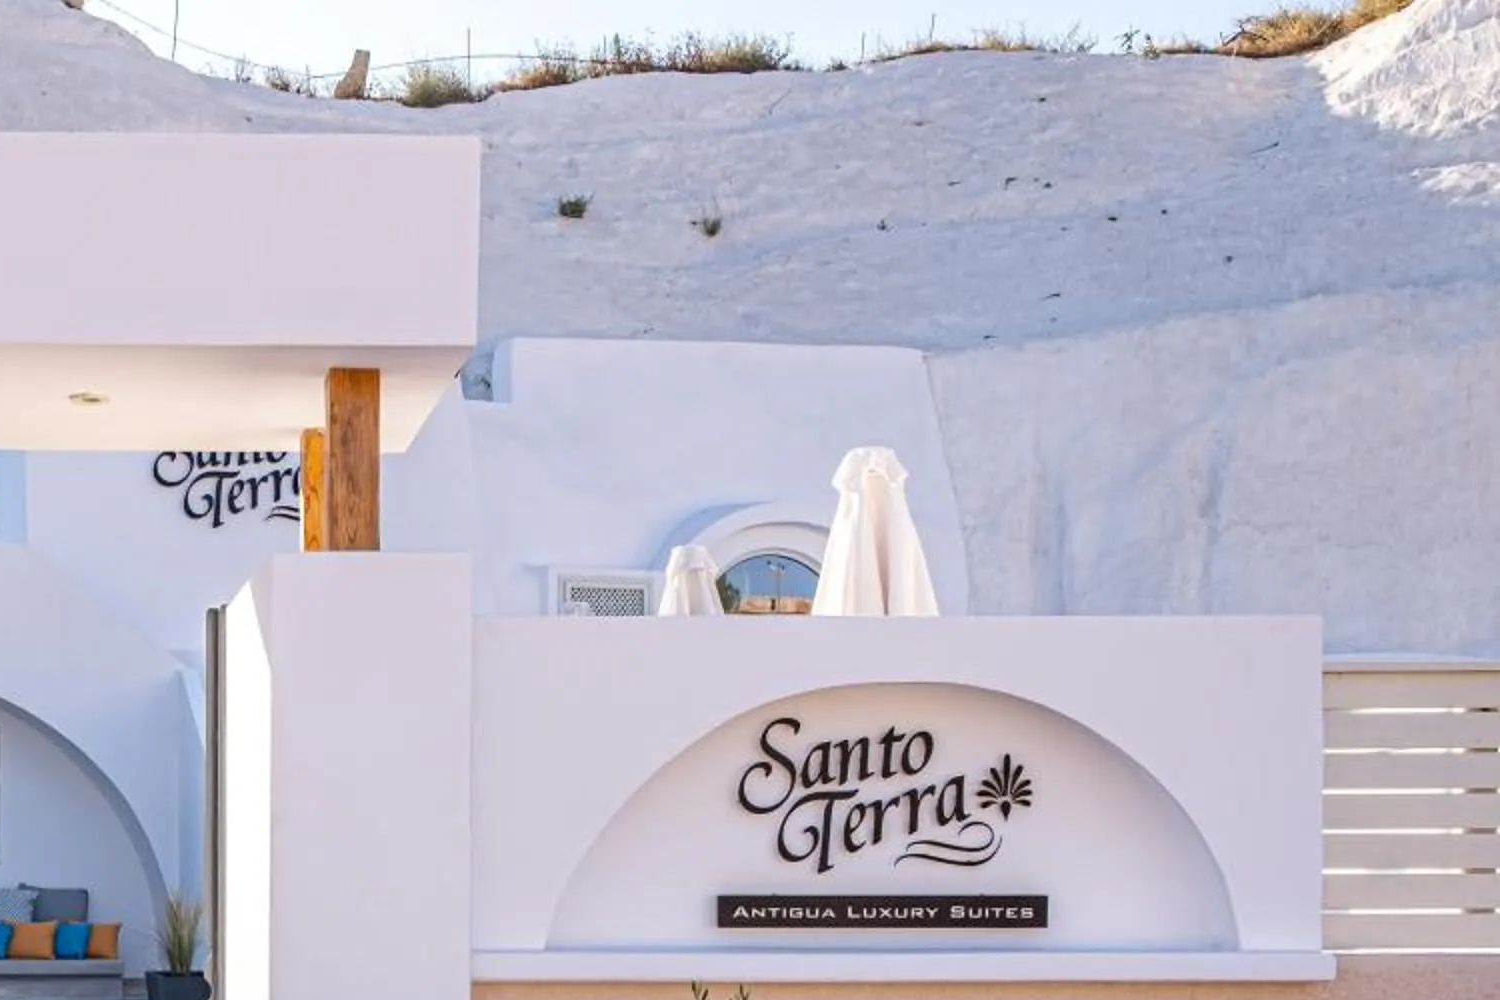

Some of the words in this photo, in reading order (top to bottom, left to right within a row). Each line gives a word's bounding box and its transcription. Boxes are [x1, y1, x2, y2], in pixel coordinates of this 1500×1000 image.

[737, 716, 936, 816] Santo
[777, 773, 973, 875] Terra
[732, 904, 837, 920] ANTIGUA
[846, 904, 939, 920] LUXURY
[949, 904, 1035, 920] SUITES
